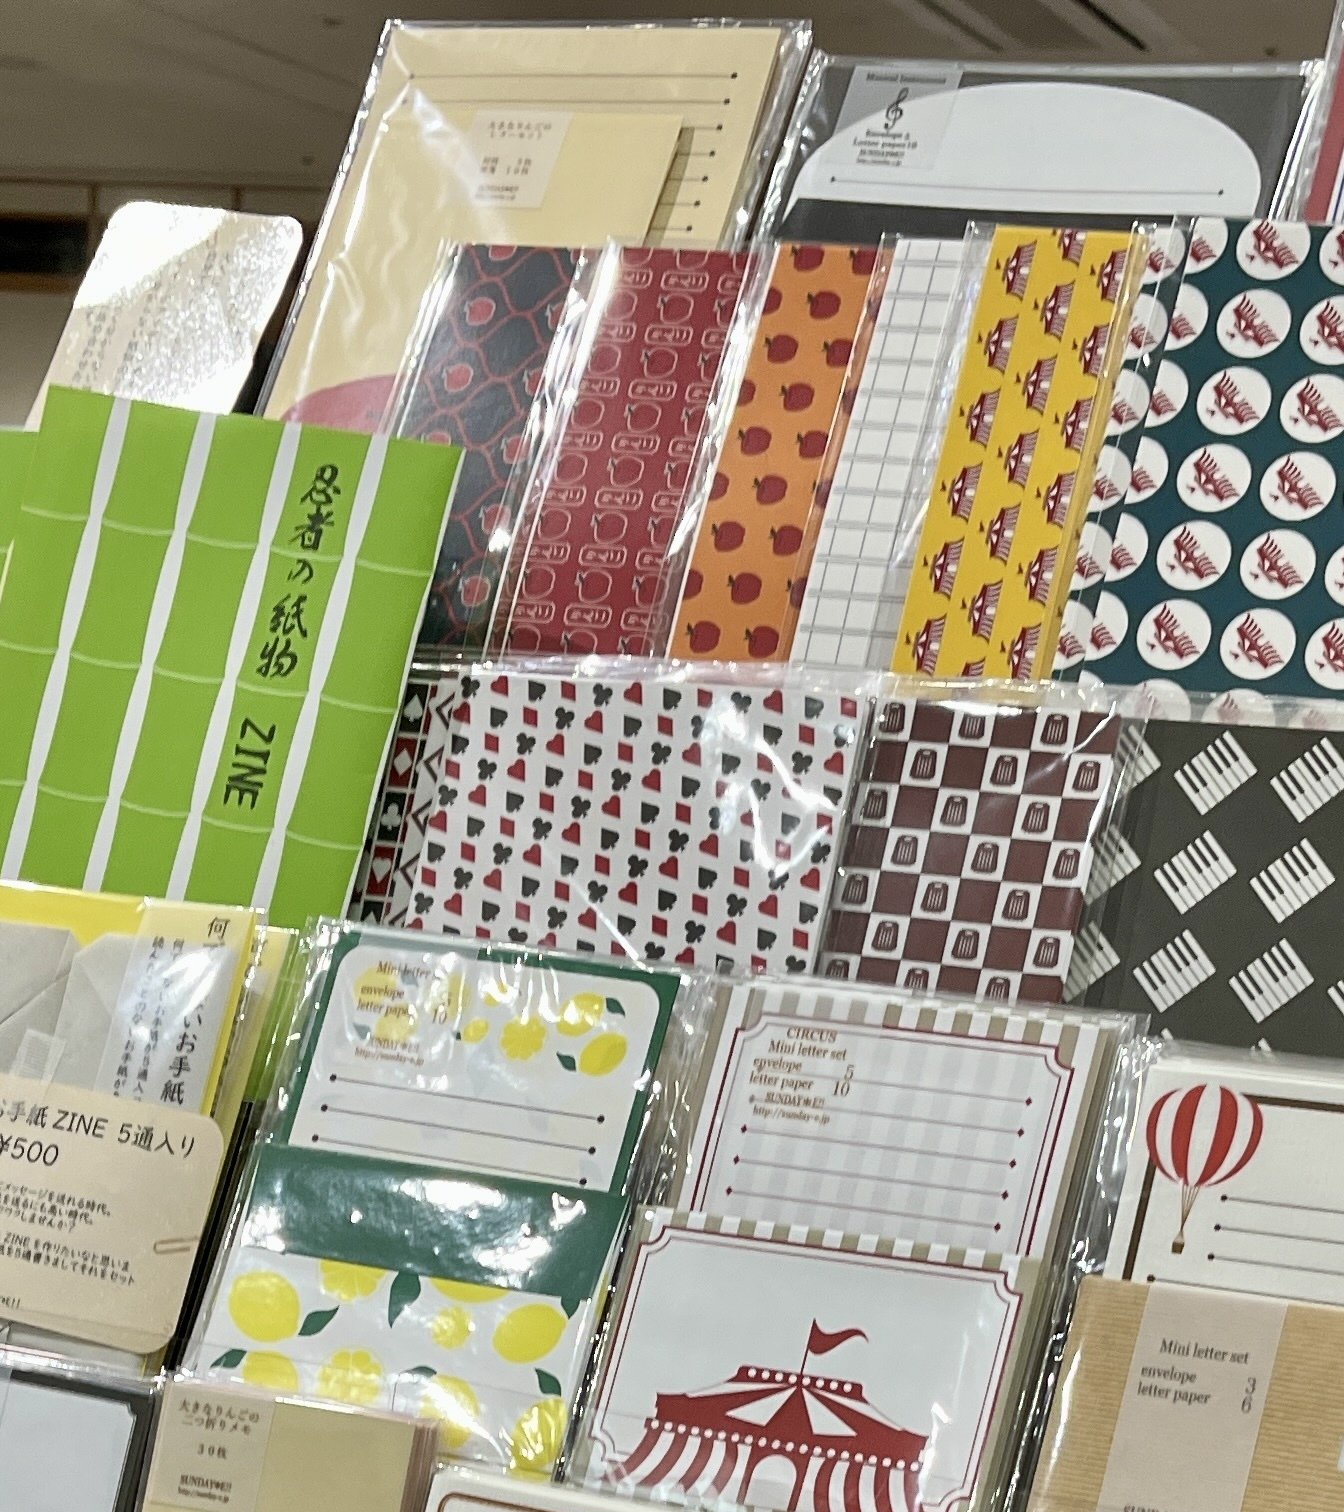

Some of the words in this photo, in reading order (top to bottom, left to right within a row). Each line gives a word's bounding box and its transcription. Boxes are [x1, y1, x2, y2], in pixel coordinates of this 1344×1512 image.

[256, 463, 342, 678] 忍者の紙物
[223, 717, 276, 811] ZINE
[360, 984, 405, 1001] envelope
[356, 999, 384, 1014] letter
[786, 1026, 838, 1044] CIRCUS
[767, 1039, 796, 1056] Mini
[797, 1042, 824, 1058] letter
[825, 1046, 848, 1061] set
[752, 1055, 803, 1074] envelope
[843, 1064, 855, 1081] 5
[749, 1072, 778, 1089] letter
[779, 1076, 815, 1092] paper
[832, 1080, 851, 1098] 10
[52, 1109, 109, 1139] ZINE
[118, 1122, 196, 1159] 5通入り
[1159, 1337, 1191, 1358] Mini
[1192, 1346, 1229, 1363] letter
[1229, 1351, 1250, 1365] set
[1141, 1364, 1197, 1384] envelope
[1245, 1377, 1257, 1395] 3
[1137, 1381, 1172, 1401] letter
[1172, 1388, 1212, 1406] paper
[1241, 1396, 1252, 1414] 6
[178, 1399, 260, 1424] 大きなりんごの
